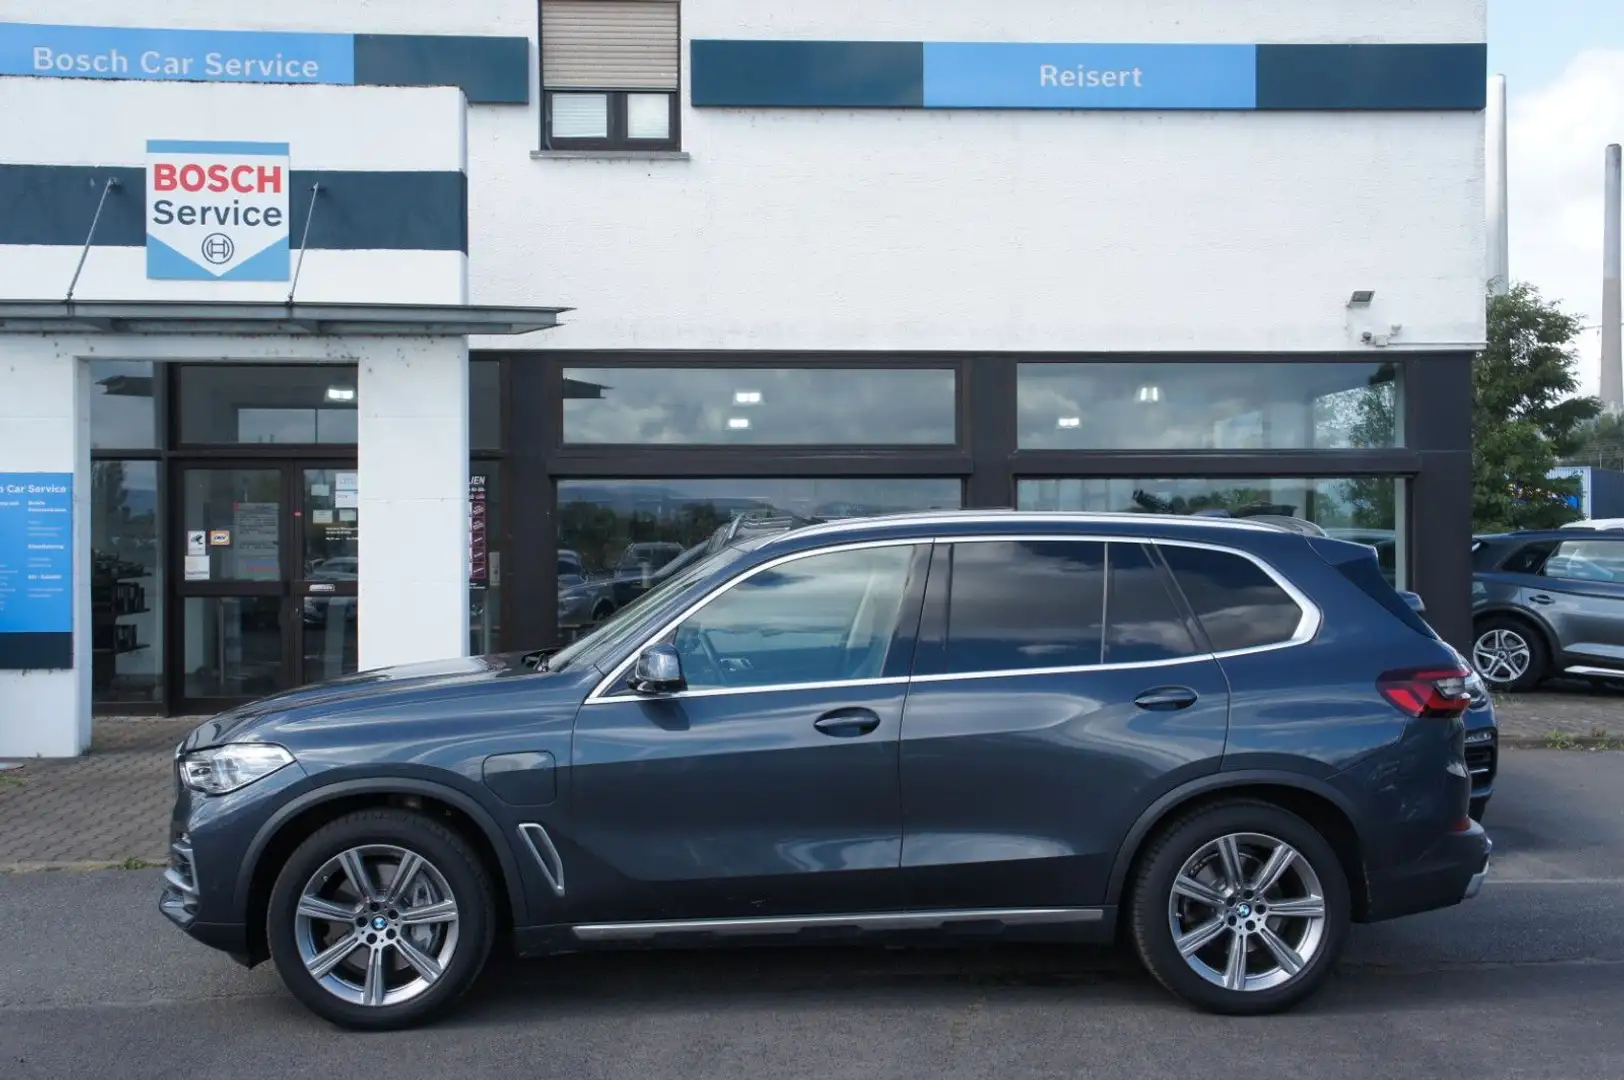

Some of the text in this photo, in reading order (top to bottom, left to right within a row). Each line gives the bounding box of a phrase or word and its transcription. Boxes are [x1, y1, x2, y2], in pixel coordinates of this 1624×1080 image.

[32, 46, 320, 78] Bosch Car Service
[1040, 63, 1143, 87] Reisert
[154, 163, 281, 193] BOSCH
[153, 199, 282, 227] Service
[7, 484, 25, 493] Car
[28, 484, 67, 493] Service
